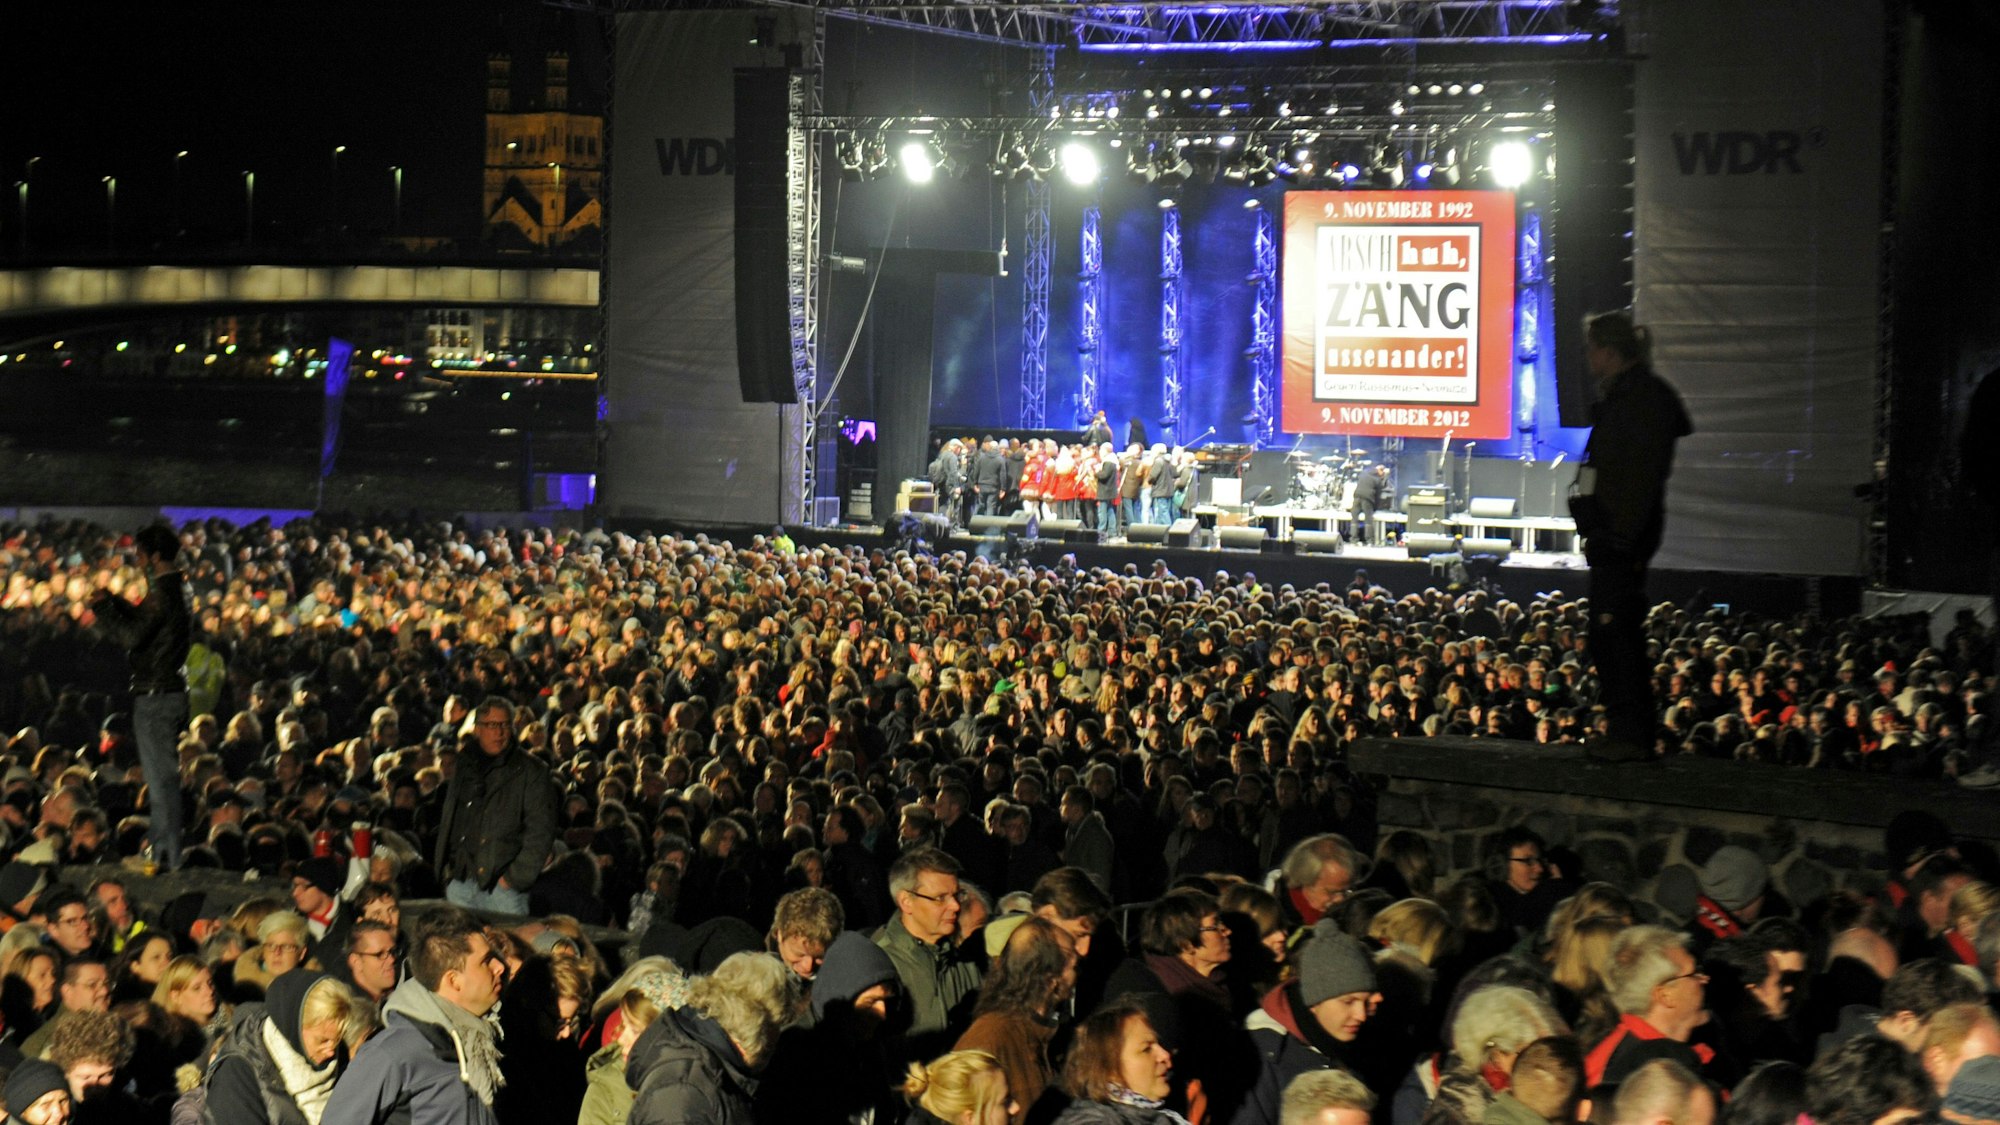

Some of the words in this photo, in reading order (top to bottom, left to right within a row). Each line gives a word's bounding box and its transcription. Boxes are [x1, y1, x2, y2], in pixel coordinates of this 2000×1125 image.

[655, 137, 735, 175] WD
[1324, 202, 1339, 218] 9.
[1343, 201, 1433, 219] NOVEMBER
[1438, 202, 1473, 218] 1992
[1401, 240, 1467, 269] huh,
[1325, 281, 1471, 330] ZÄNG
[1327, 343, 1466, 370] ussenander!
[1321, 407, 1336, 424] 9.
[1340, 407, 1429, 426] NOVEMBER
[1432, 409, 1470, 427] 2012
